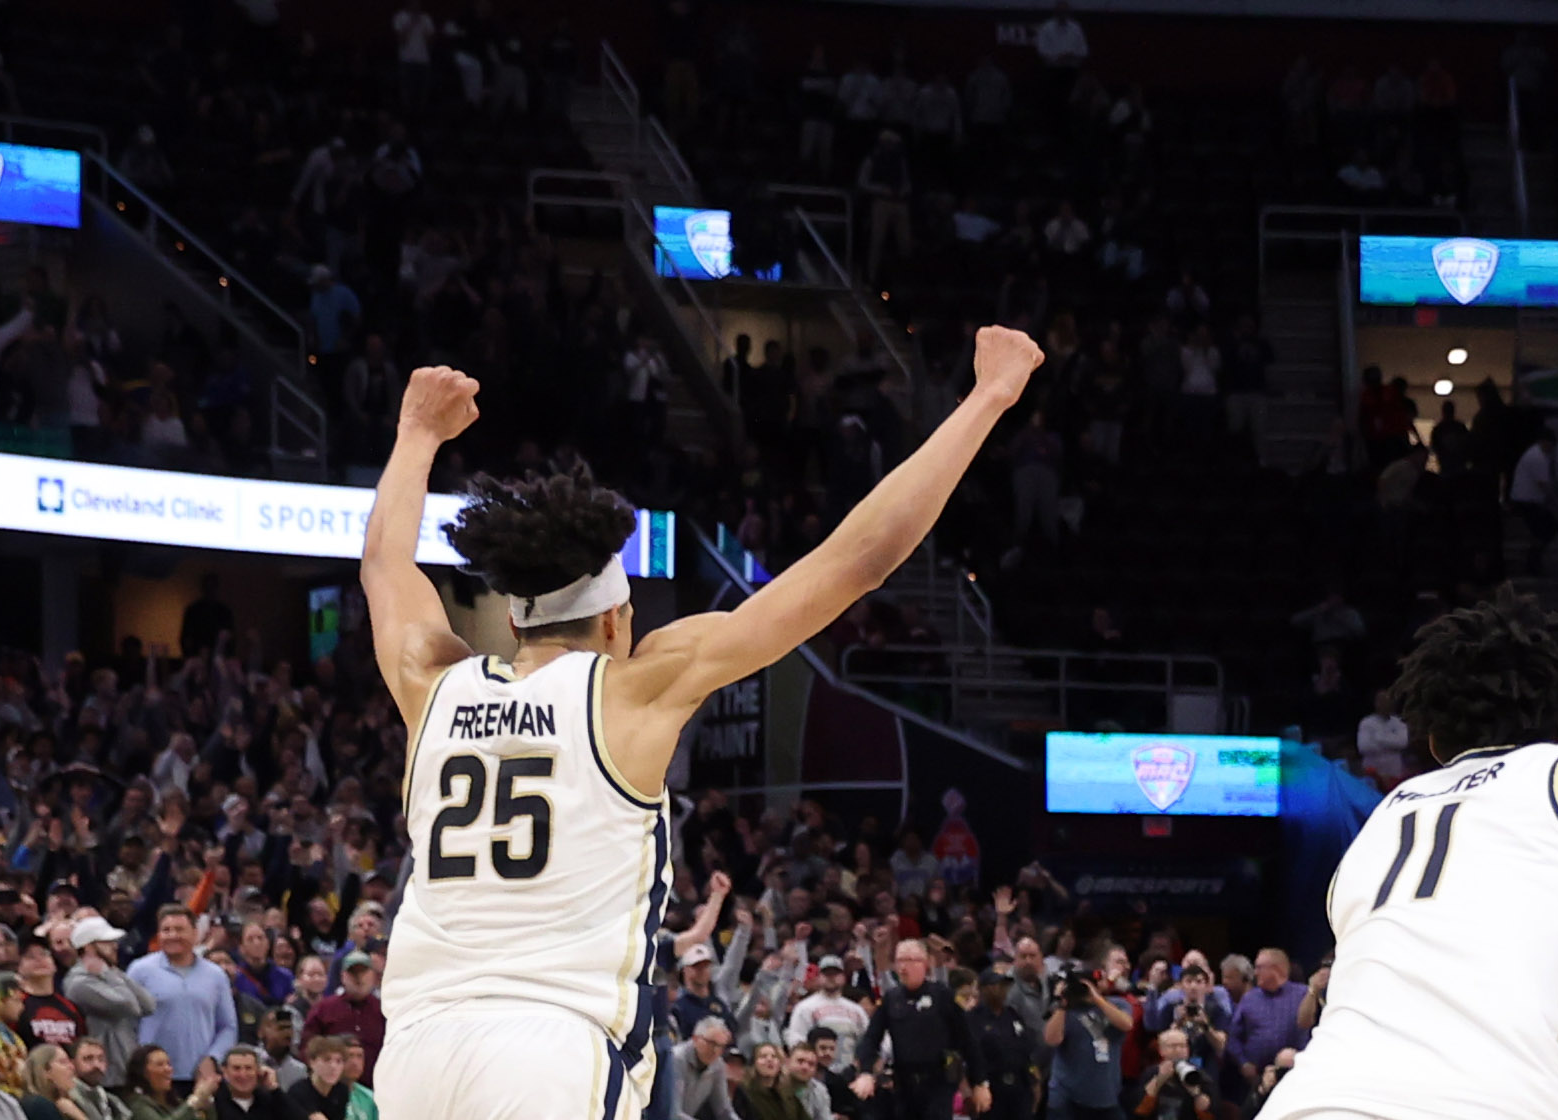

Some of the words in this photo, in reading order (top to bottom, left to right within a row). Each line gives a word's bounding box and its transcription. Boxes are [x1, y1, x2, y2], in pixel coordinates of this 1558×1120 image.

[71, 488, 166, 521] Cleveland
[171, 497, 225, 524] Clinic
[258, 503, 368, 536] SPORTS
[448, 700, 557, 740] FREEMAN
[428, 750, 558, 884] 25
[1370, 801, 1464, 915] 11
